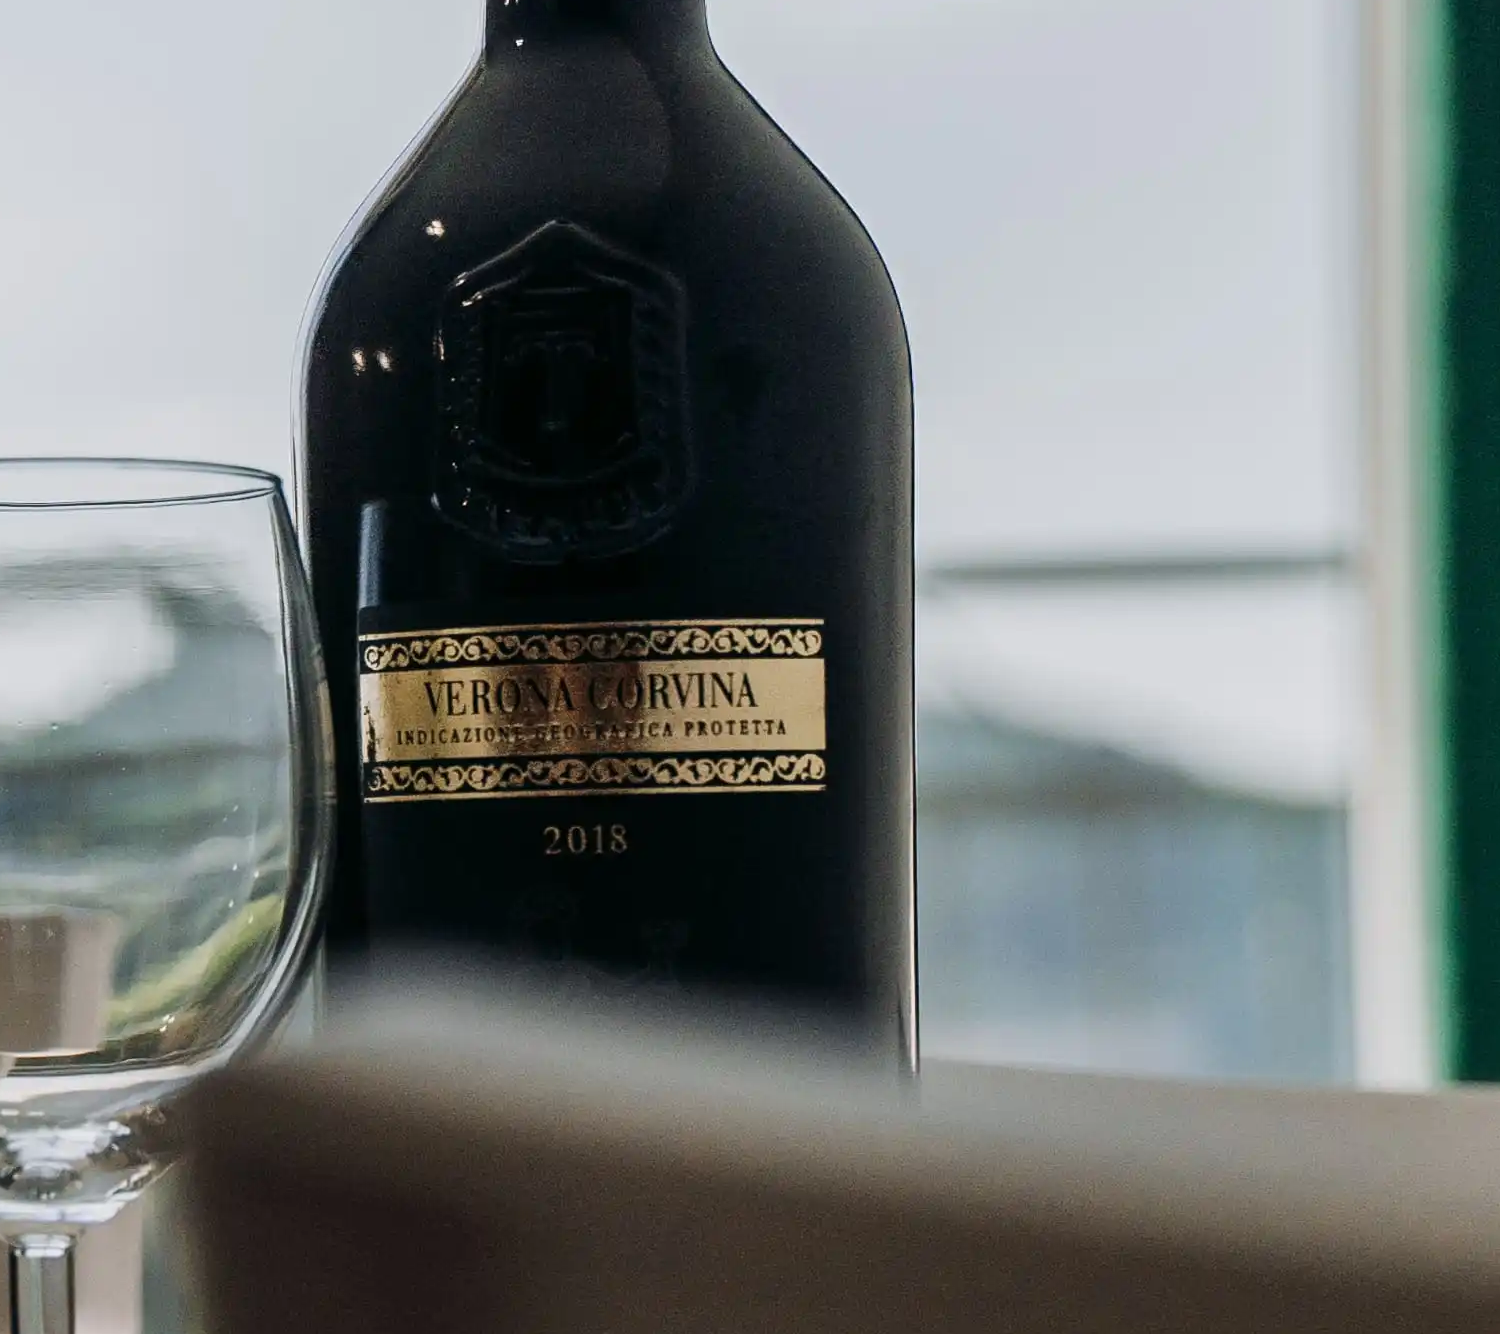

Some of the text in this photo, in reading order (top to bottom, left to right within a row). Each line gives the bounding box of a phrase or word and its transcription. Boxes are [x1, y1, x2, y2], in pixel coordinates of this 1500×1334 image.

[423, 672, 759, 717] VERONA CORVINA
[396, 725, 522, 746] INDICAZIONE
[684, 719, 787, 738] PROTETTA
[543, 823, 628, 855] 2018
